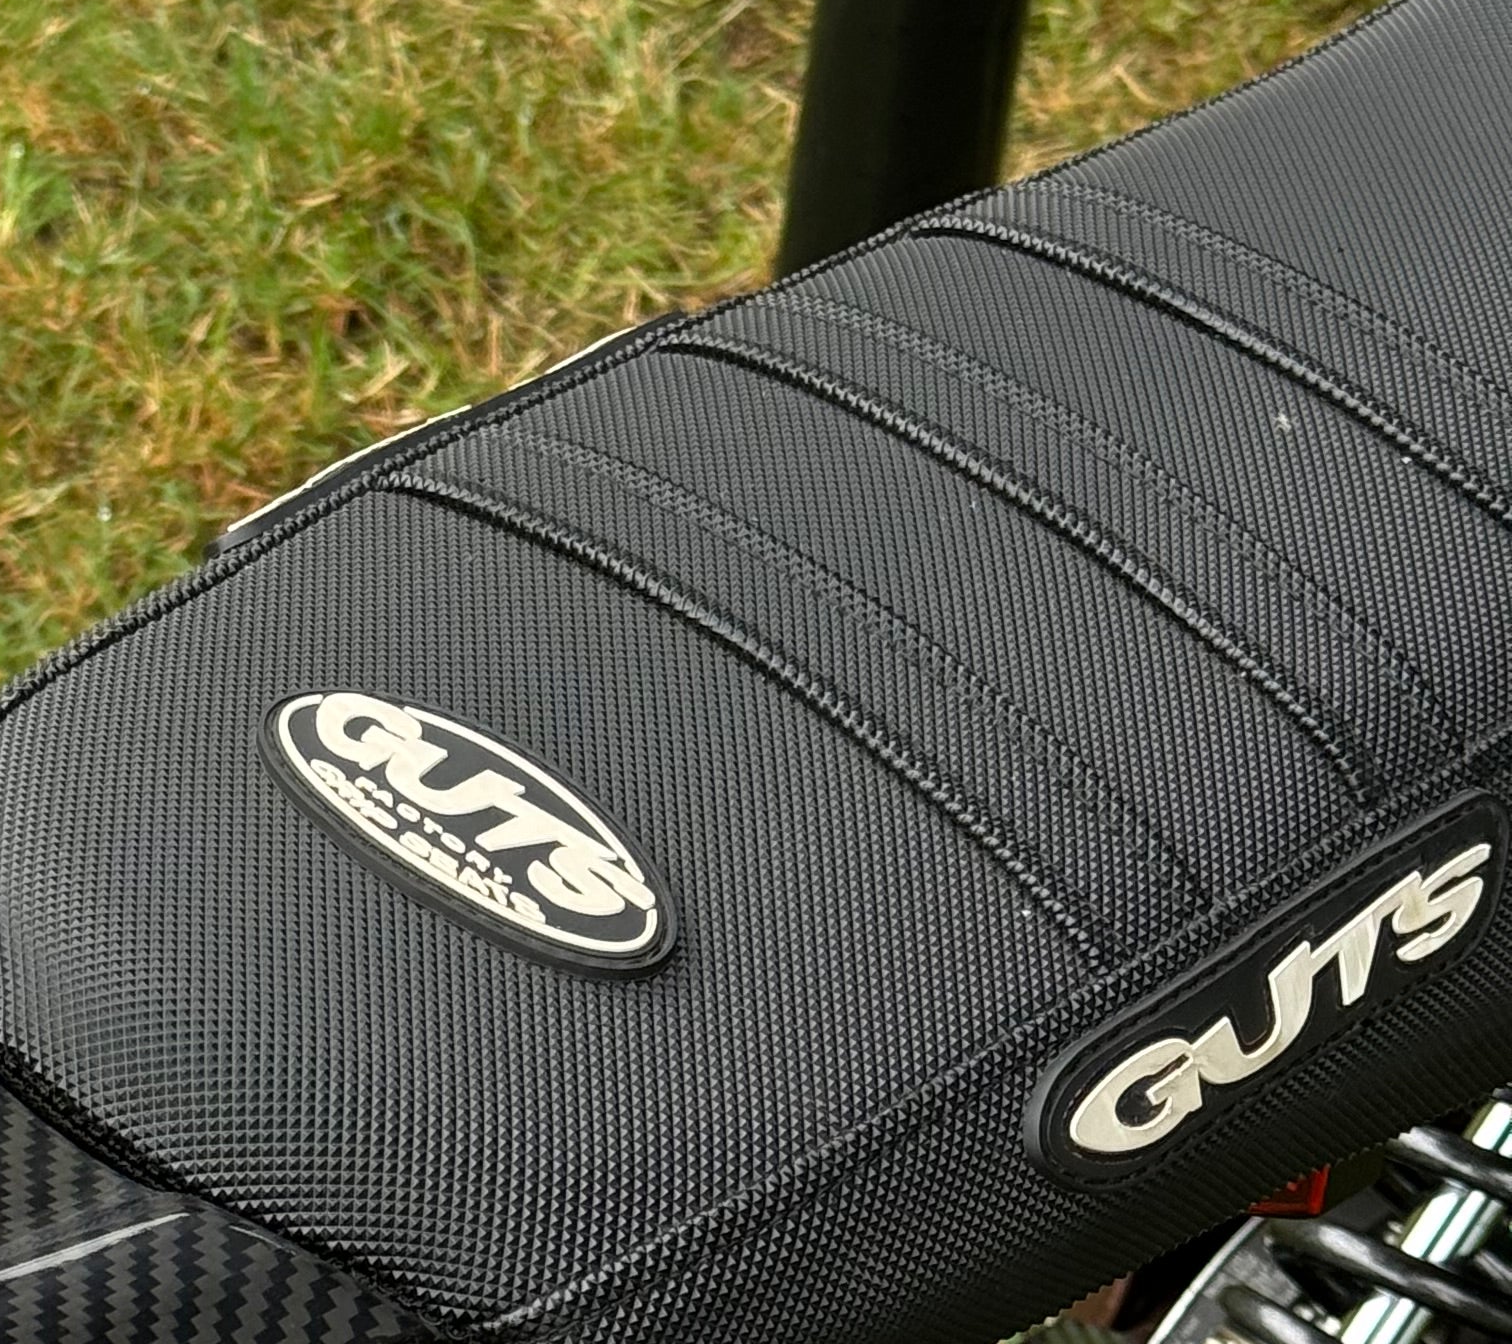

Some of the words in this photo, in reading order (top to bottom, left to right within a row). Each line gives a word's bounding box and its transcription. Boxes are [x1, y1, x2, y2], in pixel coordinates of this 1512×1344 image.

[316, 692, 656, 915] GUTS
[354, 776, 513, 885] FACTORY
[399, 830, 547, 924] SEATS
[1070, 843, 1492, 1152] GUTS
